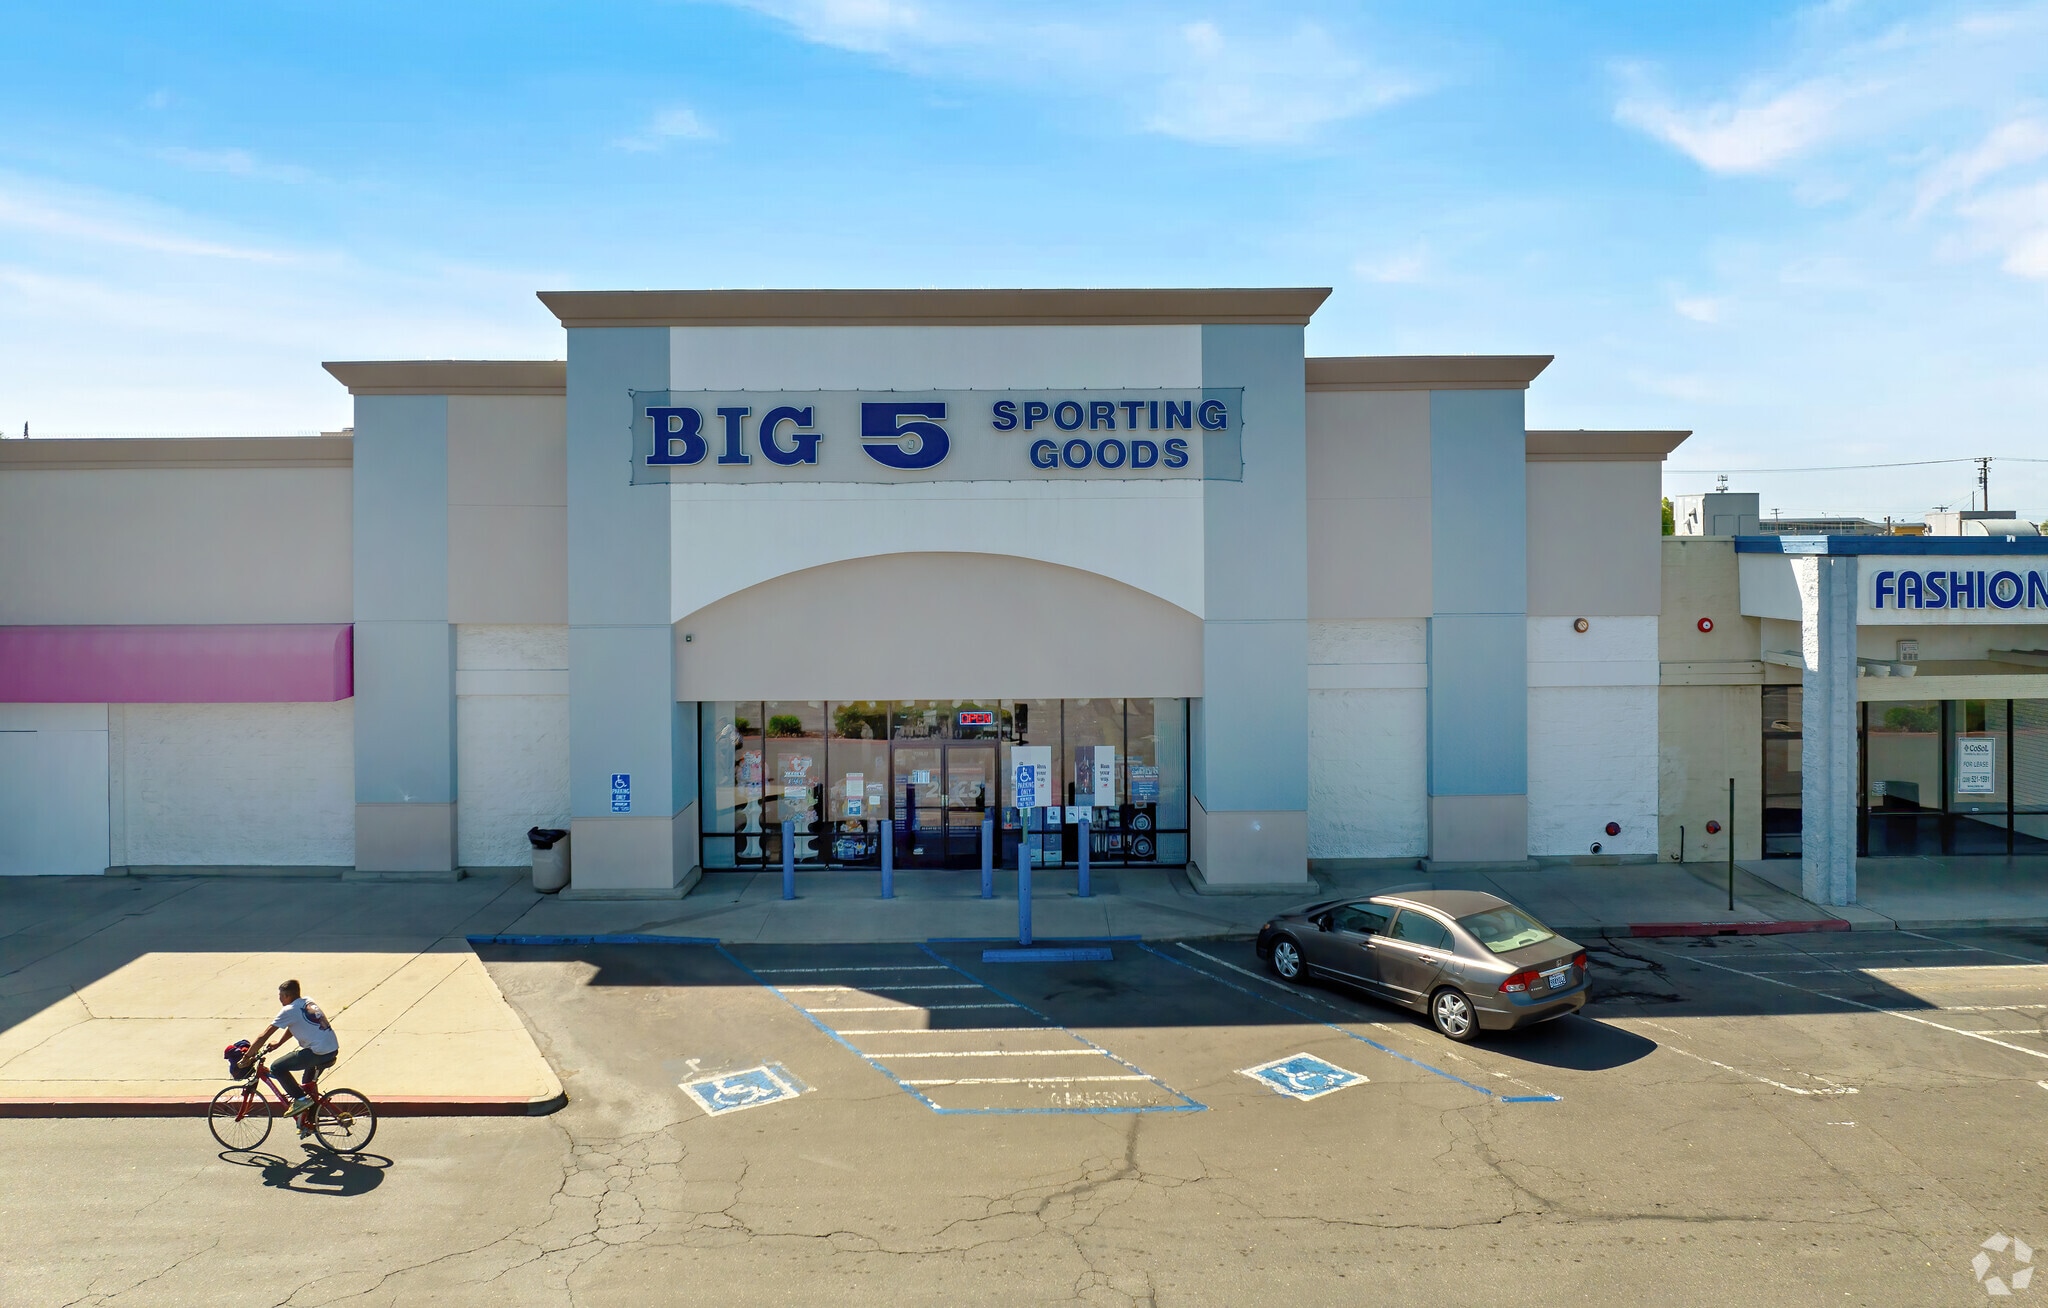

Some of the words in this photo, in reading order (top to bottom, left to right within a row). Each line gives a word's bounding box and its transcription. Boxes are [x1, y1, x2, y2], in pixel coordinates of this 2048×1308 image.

[991, 400, 1228, 431] SPORTING
[645, 405, 823, 467] BIG
[860, 401, 951, 470] 5
[1029, 438, 1190, 470] GOODS
[1874, 570, 2048, 609] FASHION
[961, 713, 991, 724] OPEN
